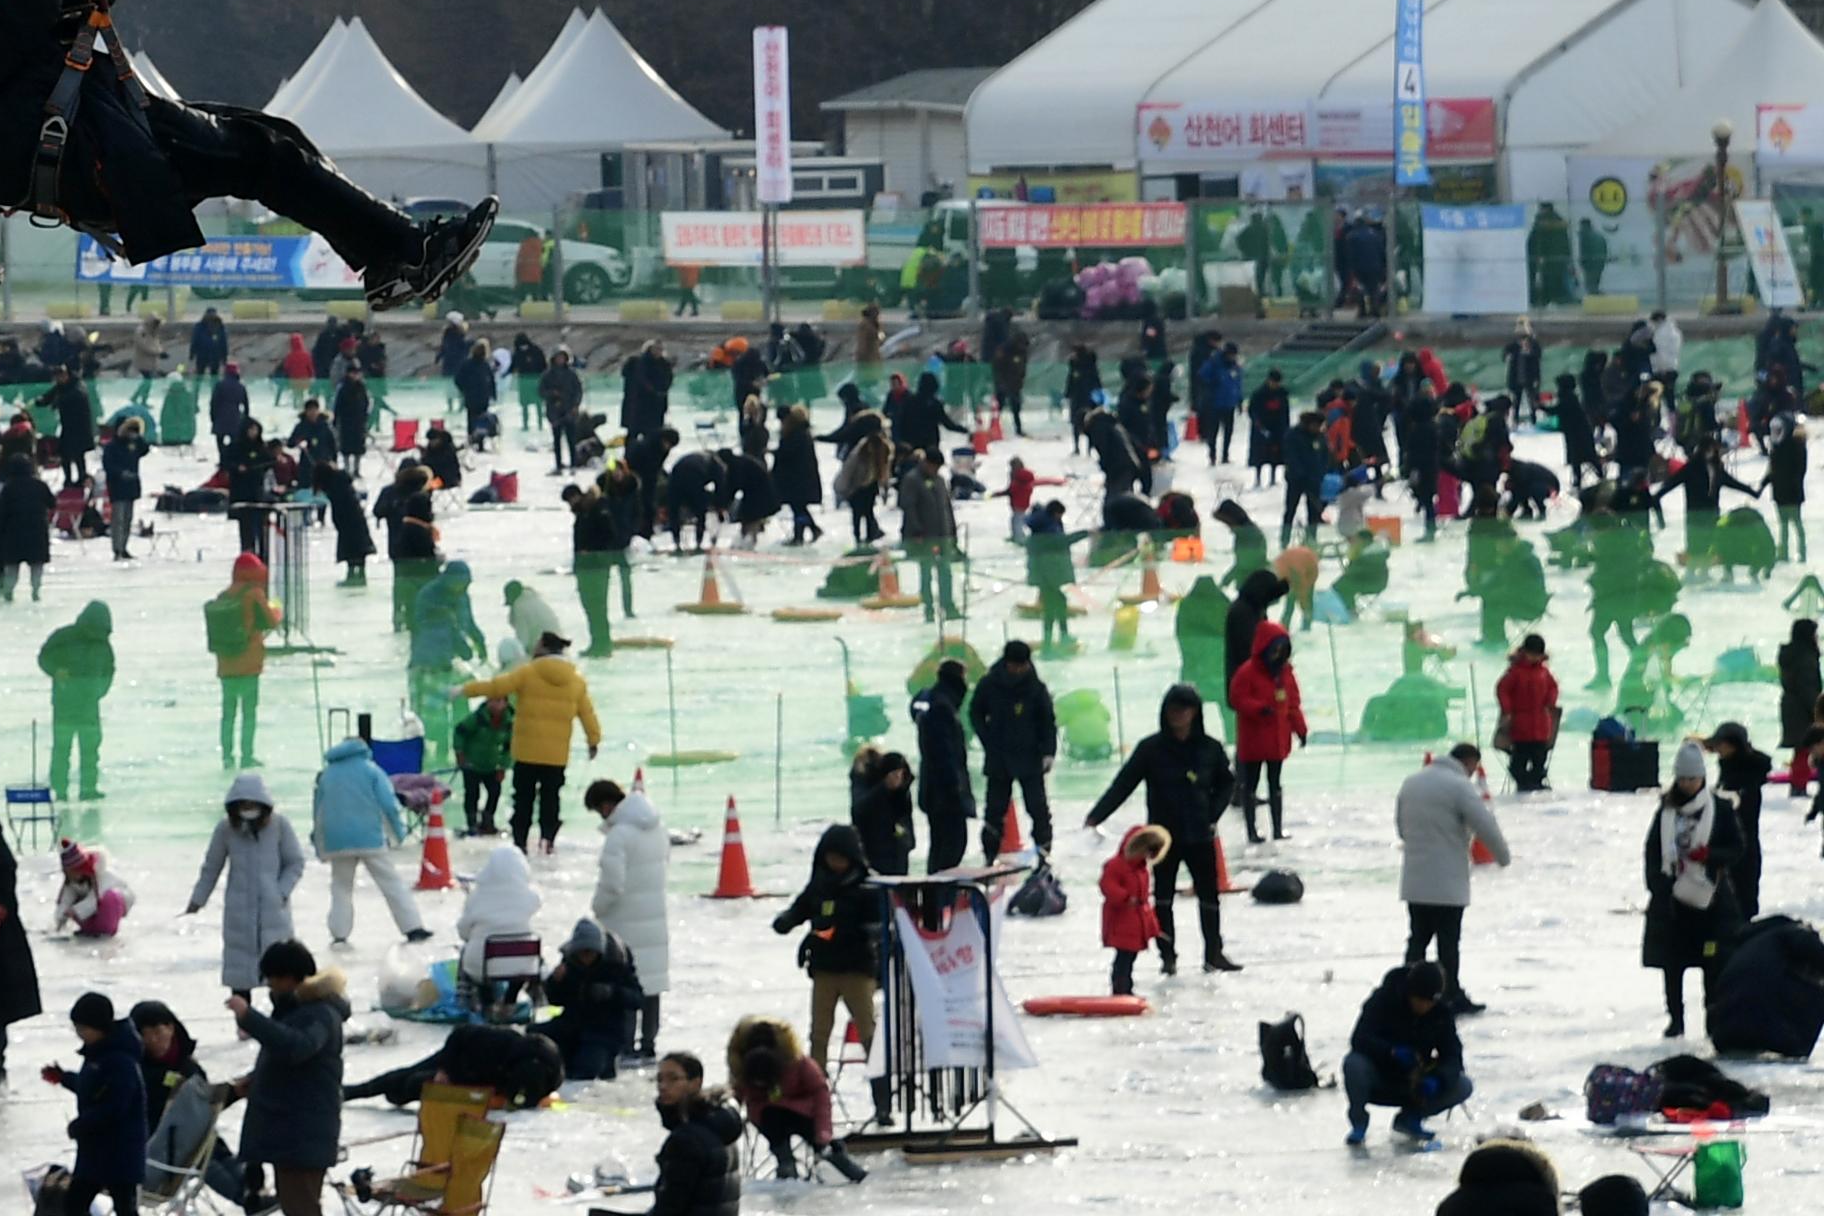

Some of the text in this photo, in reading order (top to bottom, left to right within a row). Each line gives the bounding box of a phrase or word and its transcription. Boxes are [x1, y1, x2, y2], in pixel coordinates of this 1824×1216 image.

[1404, 68, 1416, 96] 4
[1183, 112, 1242, 147] 산천어
[1248, 112, 1306, 147] 회센터
